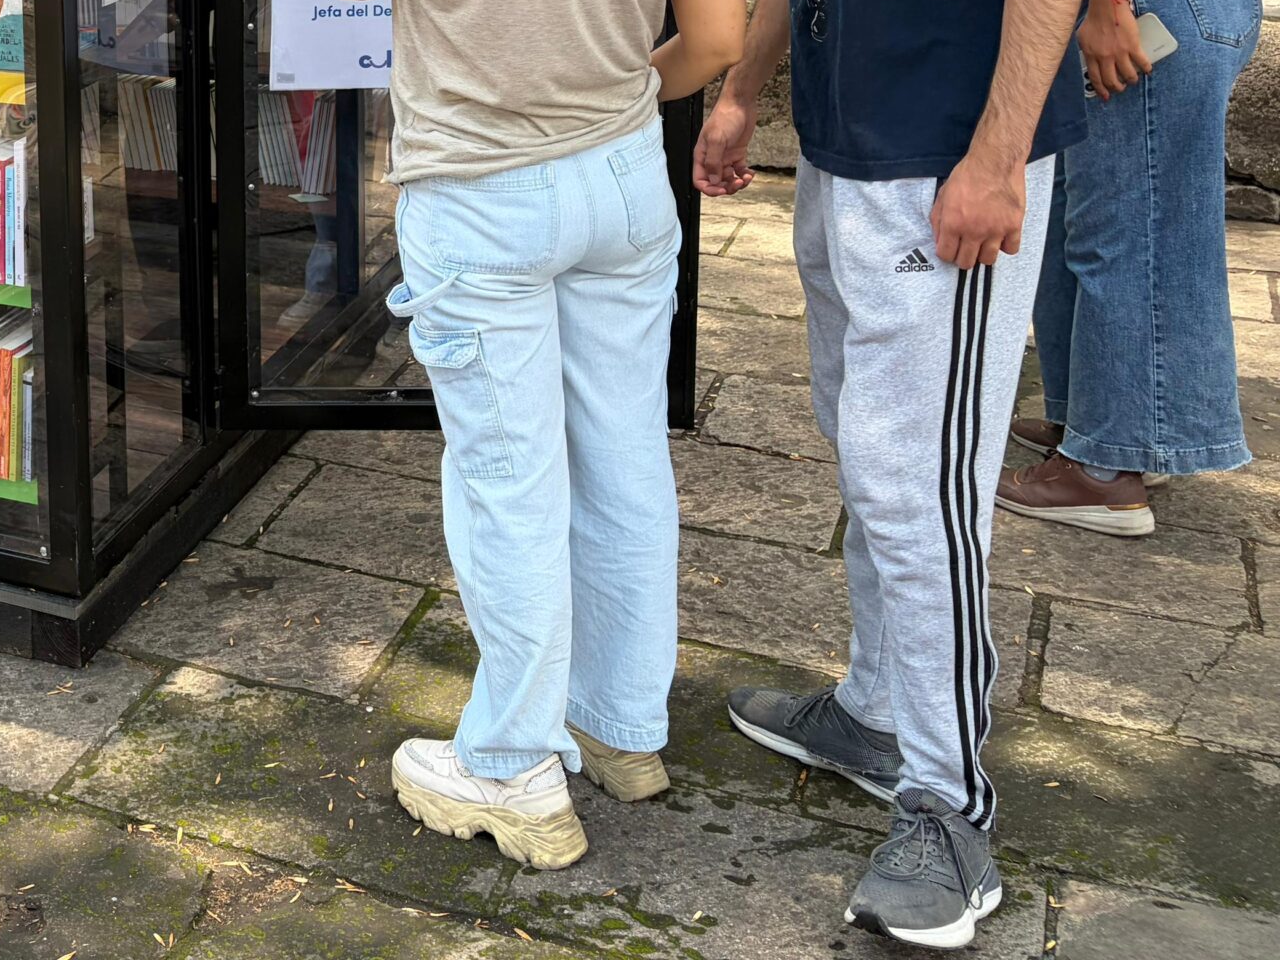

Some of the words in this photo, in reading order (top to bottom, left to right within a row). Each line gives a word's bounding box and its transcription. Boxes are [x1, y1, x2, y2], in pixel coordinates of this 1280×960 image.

[312, 5, 342, 21] Jefa
[346, 4, 369, 18] del
[894, 262, 935, 274] adidas
